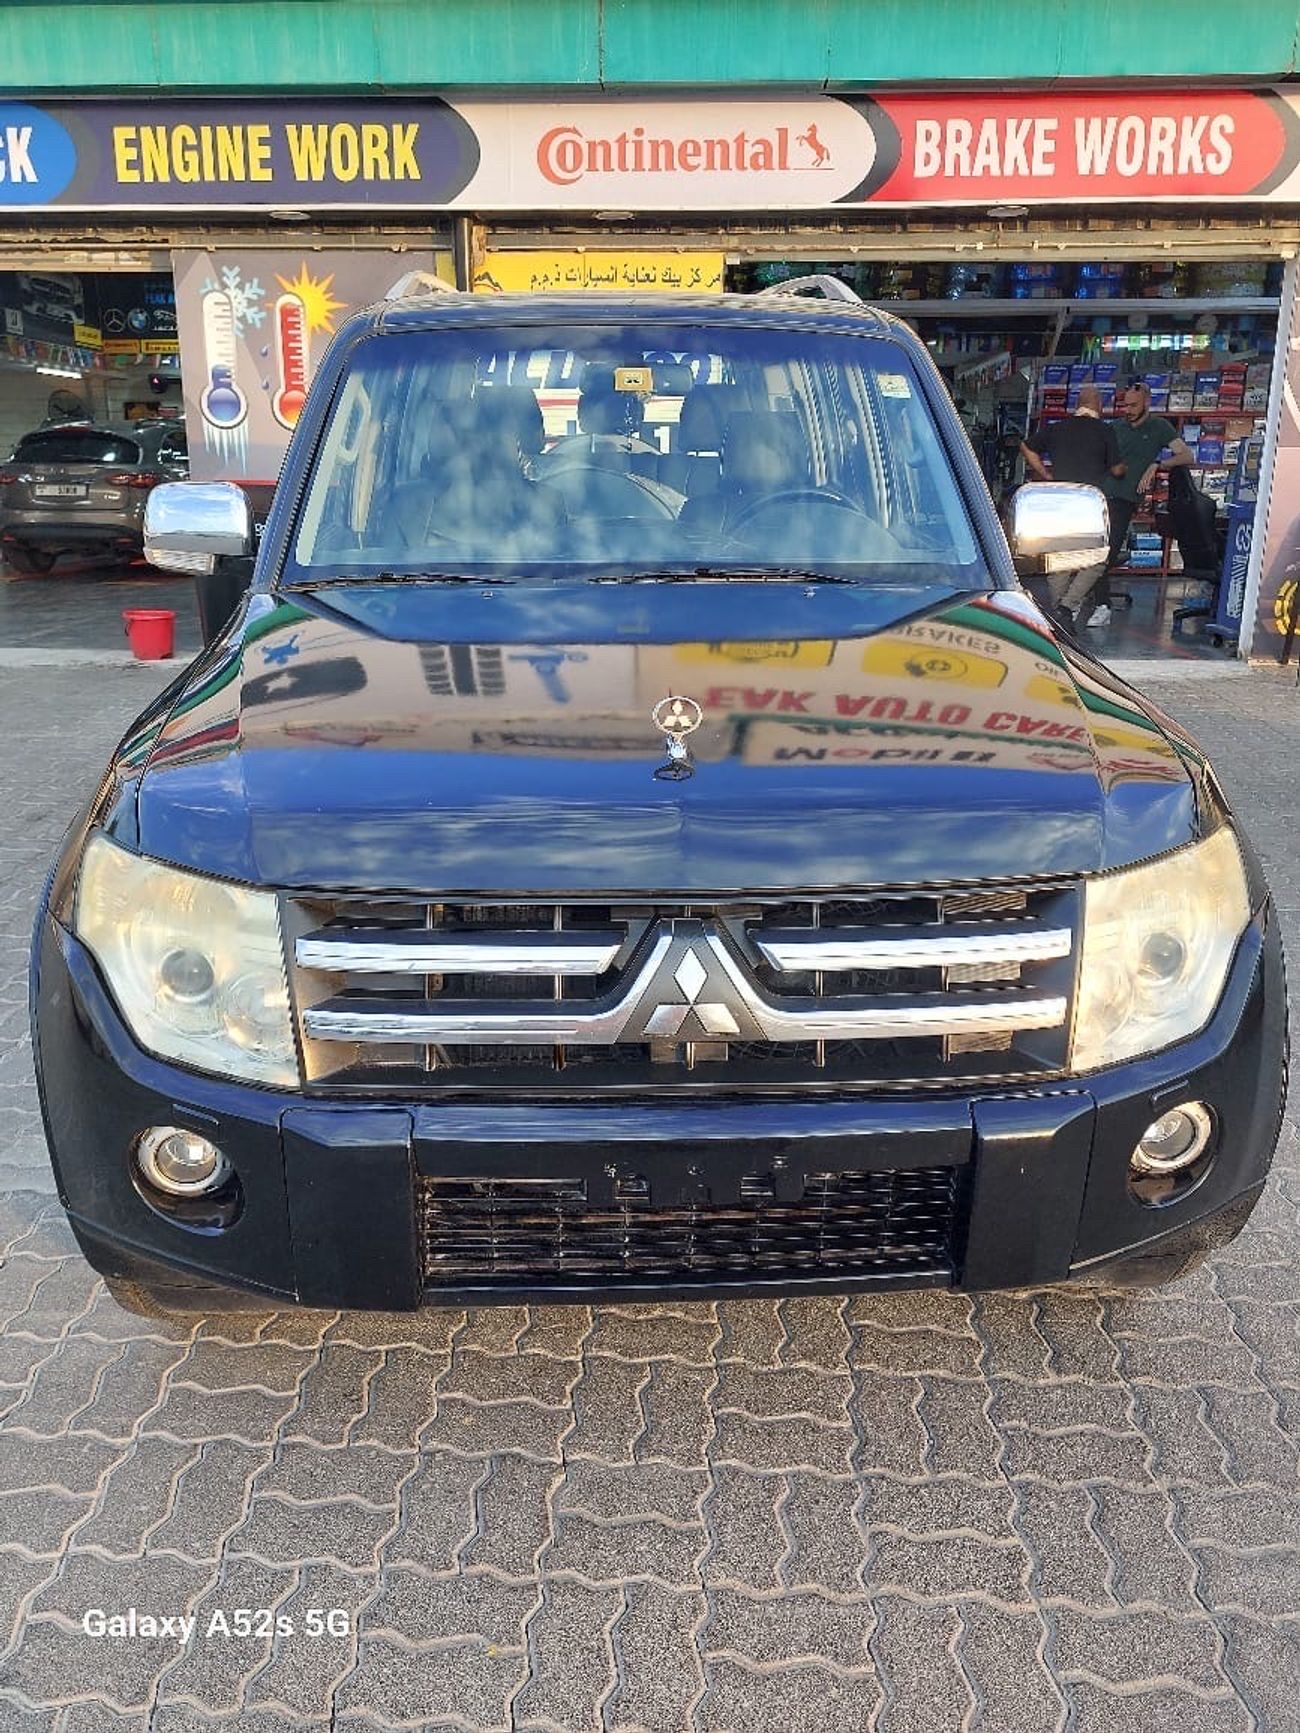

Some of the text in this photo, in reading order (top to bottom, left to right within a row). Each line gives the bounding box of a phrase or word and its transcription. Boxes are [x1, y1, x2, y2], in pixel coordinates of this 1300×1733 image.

[0, 127, 39, 183] K
[113, 122, 421, 183] ENGINE WORK
[537, 123, 791, 186] Continental
[914, 113, 1236, 178] BRAKE WORKS
